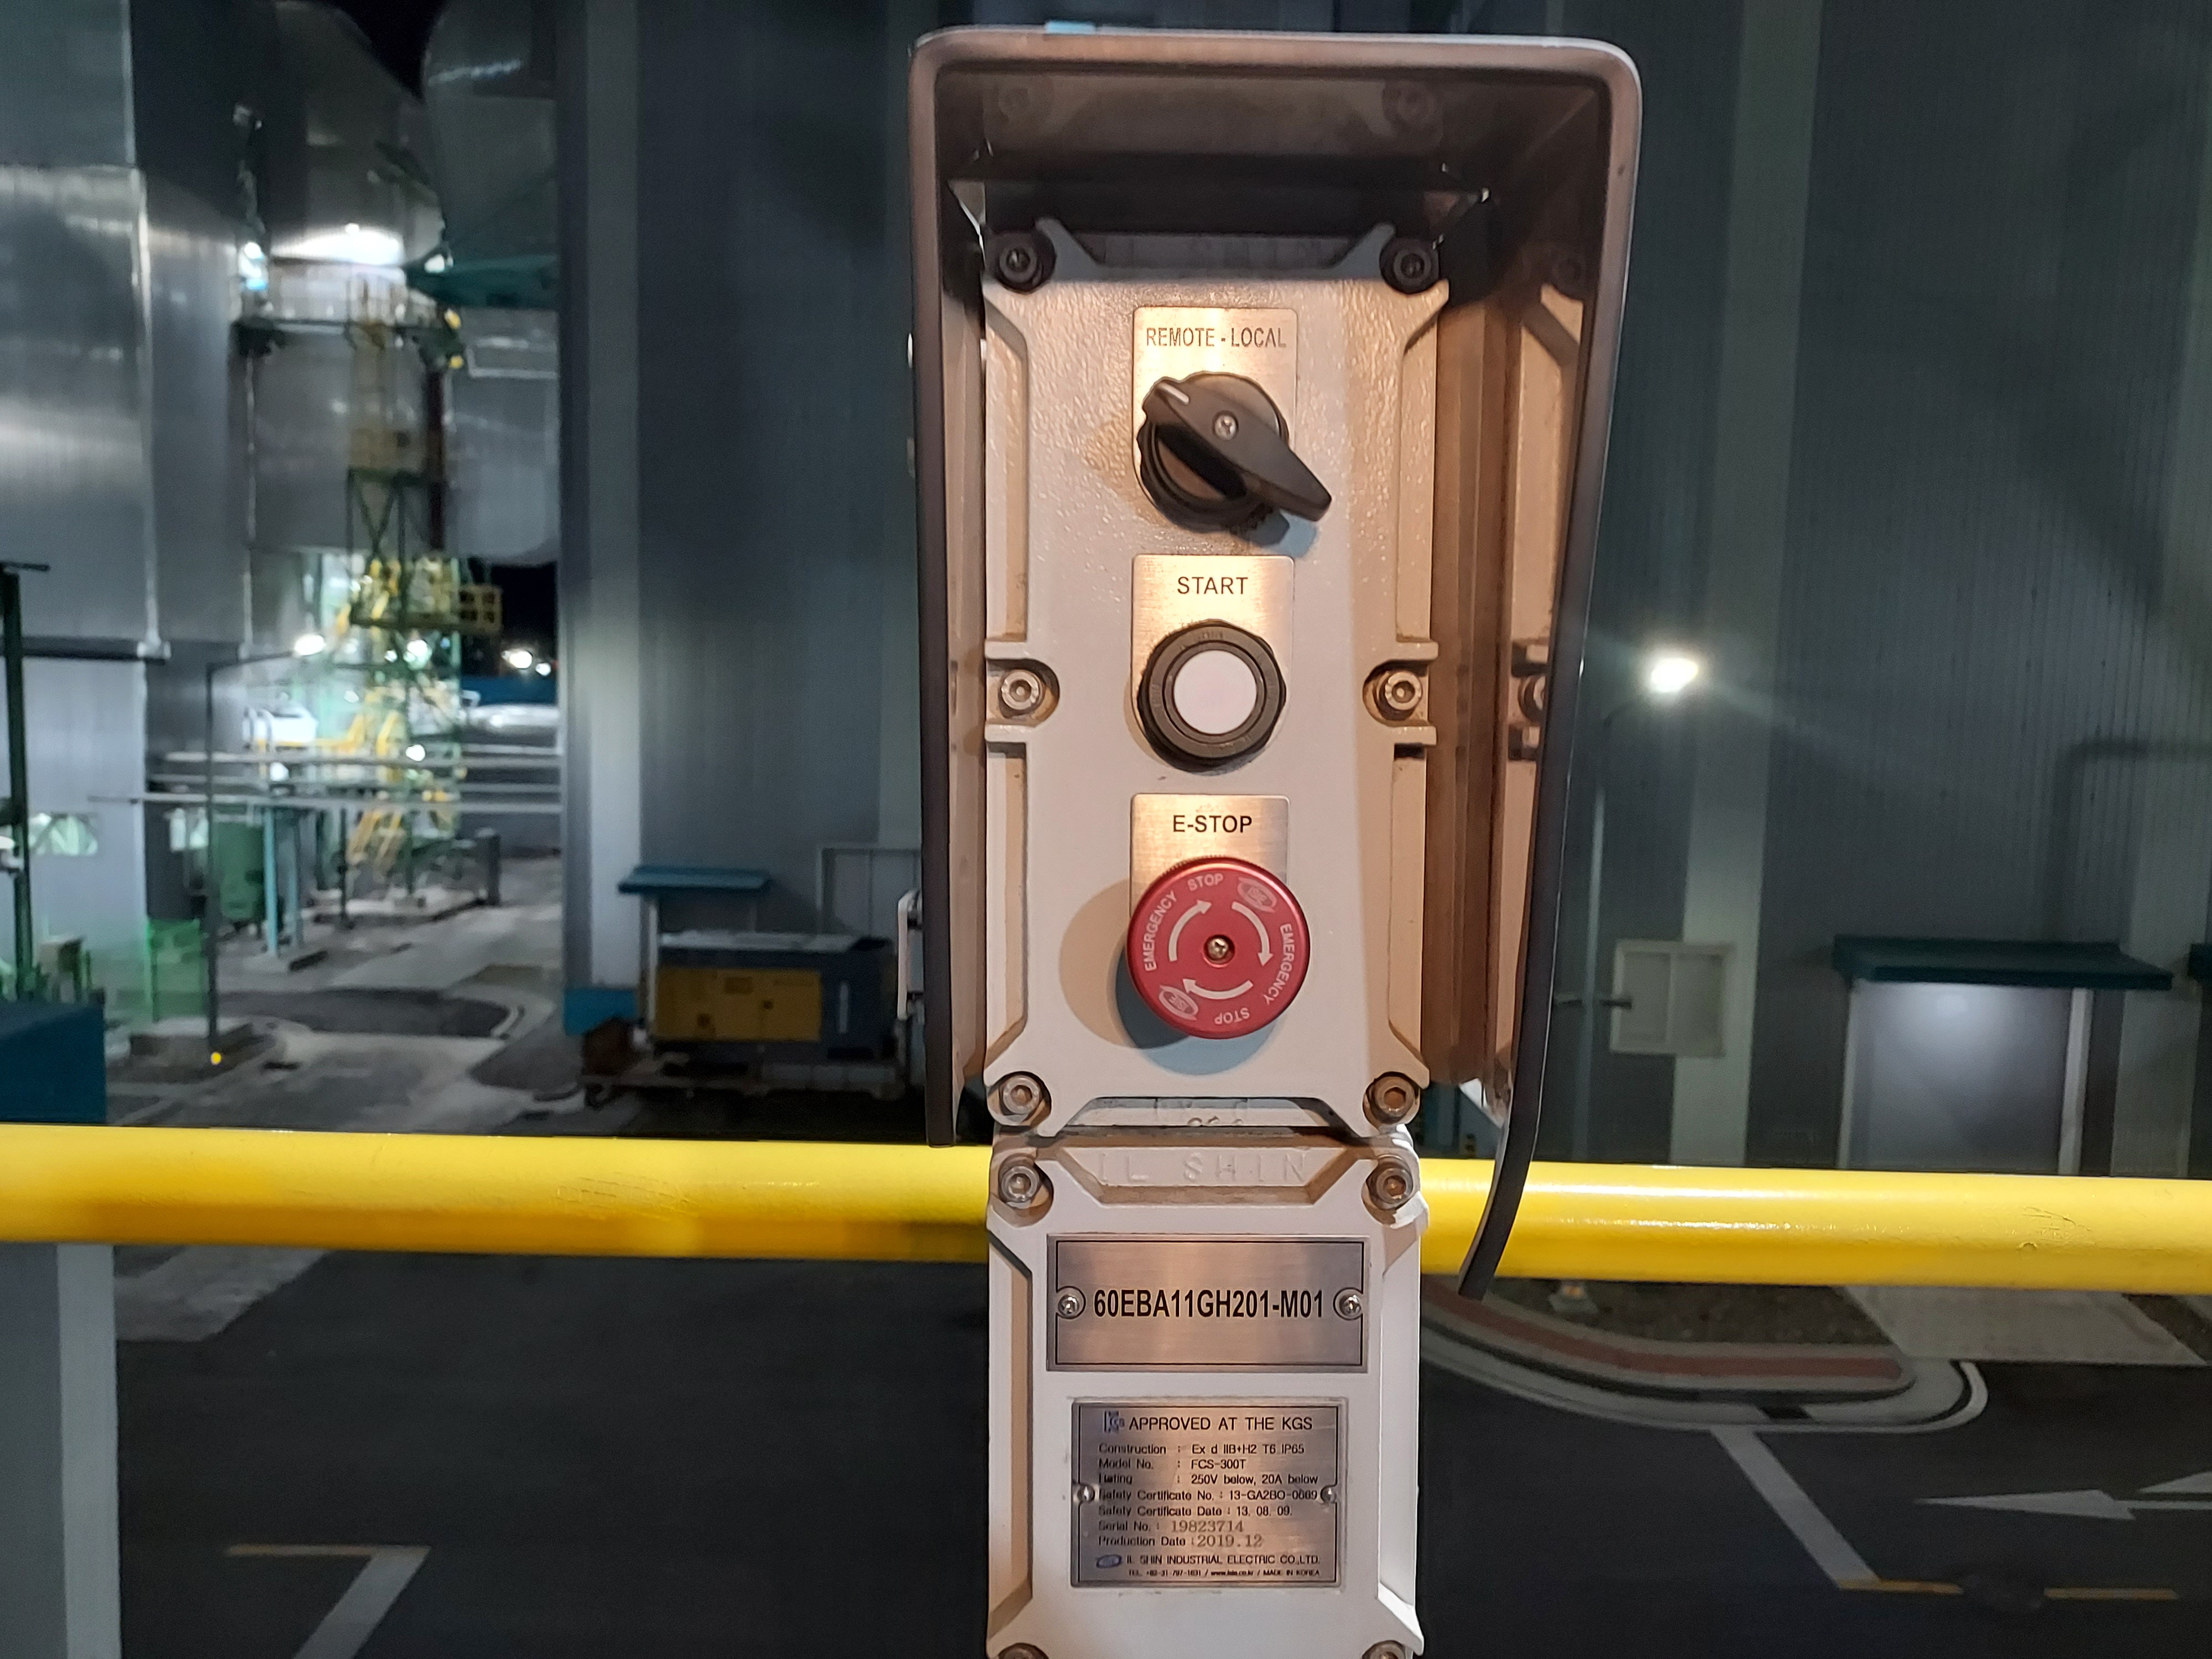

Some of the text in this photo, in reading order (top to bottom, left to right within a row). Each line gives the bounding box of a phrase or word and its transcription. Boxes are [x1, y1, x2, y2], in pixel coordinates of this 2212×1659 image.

[1146, 327, 1215, 347] REMOTE
[1231, 327, 1286, 348] LOCAL
[1177, 576, 1248, 594] START
[1173, 815, 1253, 833] E-STOP
[1142, 873, 1224, 972] EMERGENCY STOP
[1214, 923, 1295, 1025] EMERGENCY STOP
[1182, 1152, 1306, 1182] SHIN
[1094, 1290, 1323, 1318] 60EBA11GH201-M01
[1129, 1416, 1211, 1431] APPROVED
[1218, 1417, 1238, 1431] AT
[1245, 1417, 1275, 1431] THE
[1282, 1417, 1313, 1431] KGS
[1099, 1442, 1166, 1455] Construction
[1192, 1444, 1206, 1454] Ex
[1211, 1443, 1218, 1454] d
[1262, 1443, 1276, 1454] T6
[1281, 1443, 1305, 1454] IP65
[1099, 1458, 1131, 1469] Model
[1136, 1458, 1154, 1470] No.
[1191, 1459, 1246, 1470] FCS-300T
[1099, 1474, 1133, 1485] Rating
[1191, 1474, 1218, 1485] 250V
[1224, 1474, 1256, 1486] below,
[1262, 1474, 1282, 1485] 20A
[1288, 1474, 1318, 1485] below
[1099, 1489, 1131, 1501] Safety
[1137, 1489, 1192, 1501] Certificate
[1197, 1490, 1214, 1501] No.
[1099, 1505, 1131, 1517] Safety
[1137, 1505, 1192, 1517] Certificate
[1197, 1506, 1222, 1516] Date
[1237, 1506, 1250, 1517] 13.
[1277, 1506, 1292, 1516] 09.
[1099, 1520, 1128, 1531] Serial
[1134, 1520, 1151, 1532] No.
[1171, 1520, 1244, 1533] 19823714
[1099, 1535, 1155, 1547] Production
[1161, 1536, 1186, 1546] Date
[1140, 1555, 1162, 1564] SHIN
[1167, 1555, 1223, 1564] INDUSTRIAL
[1227, 1554, 1275, 1564] ELECTRIC
